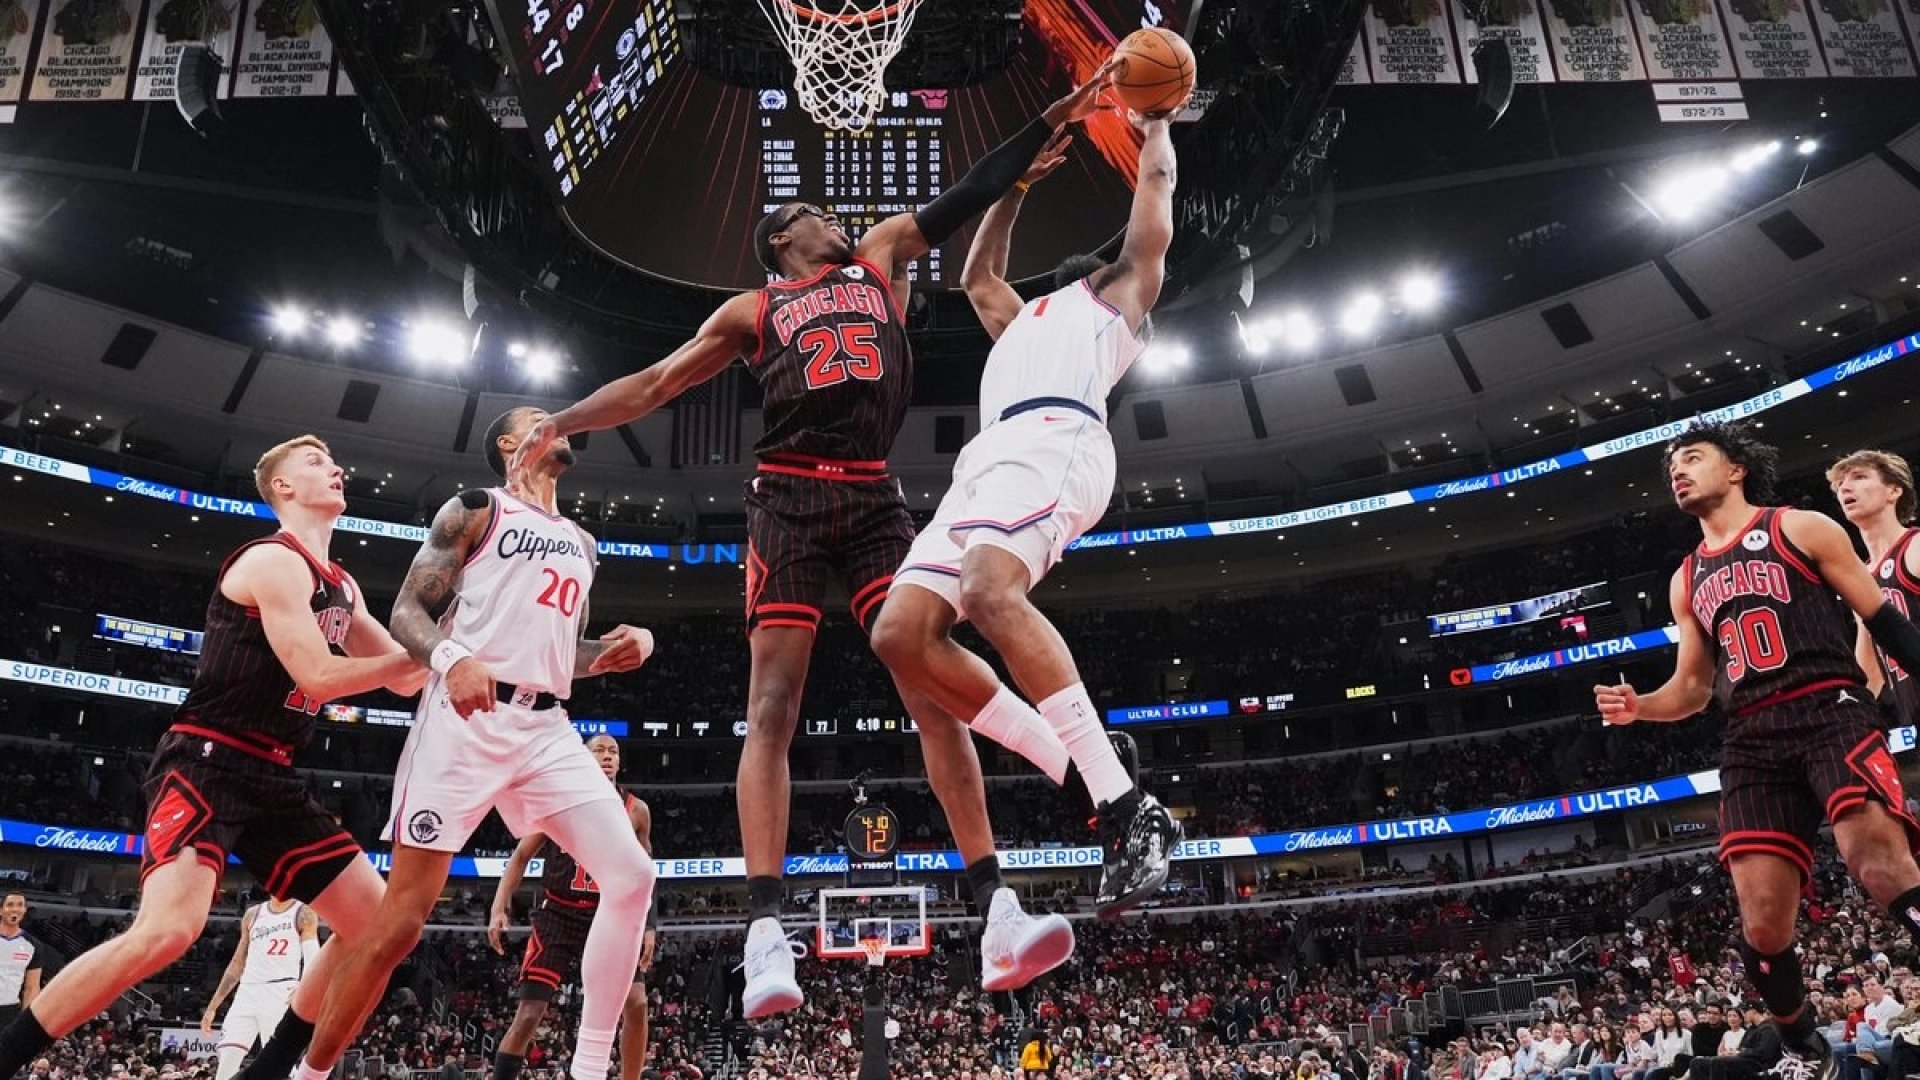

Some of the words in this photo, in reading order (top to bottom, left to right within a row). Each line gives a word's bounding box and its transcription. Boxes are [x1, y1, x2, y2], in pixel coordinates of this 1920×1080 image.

[1387, 28, 1431, 37] CHICAGO
[1570, 28, 1614, 37] CHICAGO
[1658, 25, 1702, 34] CHICAGO
[1749, 24, 1791, 33] CHICAGO
[263, 41, 310, 50] CHICAGO
[1376, 37, 1445, 47] BLACKHAWKS
[1560, 36, 1628, 47] BLACKHAWKS
[1649, 33, 1717, 43] BLACKHAWKS
[63, 46, 111, 55] CHICAGO
[249, 51, 321, 62] BLACKHAWKS
[1564, 54, 1632, 63] CONFERENCE
[1654, 51, 1721, 60] CONFERENCE
[47, 56, 121, 66] BLACKHAWKS
[238, 63, 285, 73] CENTRAL
[287, 62, 330, 72] DIVISION
[1380, 55, 1448, 64] CONFERENCE
[1572, 62, 1630, 72] CHAMPIONS
[1660, 59, 1719, 69] CHAMPIONS
[38, 67, 76, 76] NORRIS
[78, 67, 126, 76] DIVISION
[1386, 64, 1444, 73] CHAMPIONS
[48, 78, 112, 88] CHAMPIONS
[251, 74, 313, 84] CHAMPIONS
[772, 284, 888, 346] CHICAGO
[798, 322, 884, 391] 25
[1834, 346, 1894, 382] Michelob
[1604, 422, 1684, 455] SUPERIOR
[1742, 390, 1783, 415] BEER
[13, 452, 63, 473] BEER
[1434, 476, 1489, 500] Michelob
[1503, 456, 1561, 484] ULTRA
[116, 476, 177, 502] Michelob
[192, 495, 256, 517] ULTRA
[1228, 512, 1299, 533] SUPERIOR
[1304, 504, 1344, 523] LIGHT
[1350, 496, 1388, 513] BEER
[336, 518, 385, 534] ERIOR
[498, 528, 584, 560] Clippers
[1071, 534, 1118, 550] Michelob
[1133, 526, 1188, 543] ULTRA
[598, 542, 654, 558] ULTRA
[536, 567, 580, 617] 20
[1692, 559, 1792, 636] CHICAGO
[1718, 606, 1788, 683] 30
[1492, 655, 1551, 681] Michelob
[1567, 636, 1638, 663] ULTRA
[12, 663, 110, 692] SUPERIOR
[117, 678, 170, 701] LIGHT
[1127, 709, 1161, 720] ULTRA
[1172, 704, 1209, 717] CLUB
[572, 722, 608, 734] CLUB
[855, 717, 881, 731] 4:10
[1486, 802, 1555, 829] Michelob
[1577, 783, 1660, 814] ULTRA
[861, 815, 889, 830] 4:10
[35, 826, 118, 853] Michelob
[866, 829, 886, 853] 12
[1285, 827, 1353, 852] Michelob
[1373, 816, 1454, 841] ULTRA
[1172, 841, 1221, 857] BEER
[787, 856, 849, 875] Michelo
[896, 853, 949, 870] LTRA
[1007, 849, 1102, 866] SUPERIOR
[674, 860, 724, 875] BEER
[267, 938, 289, 956] 22
